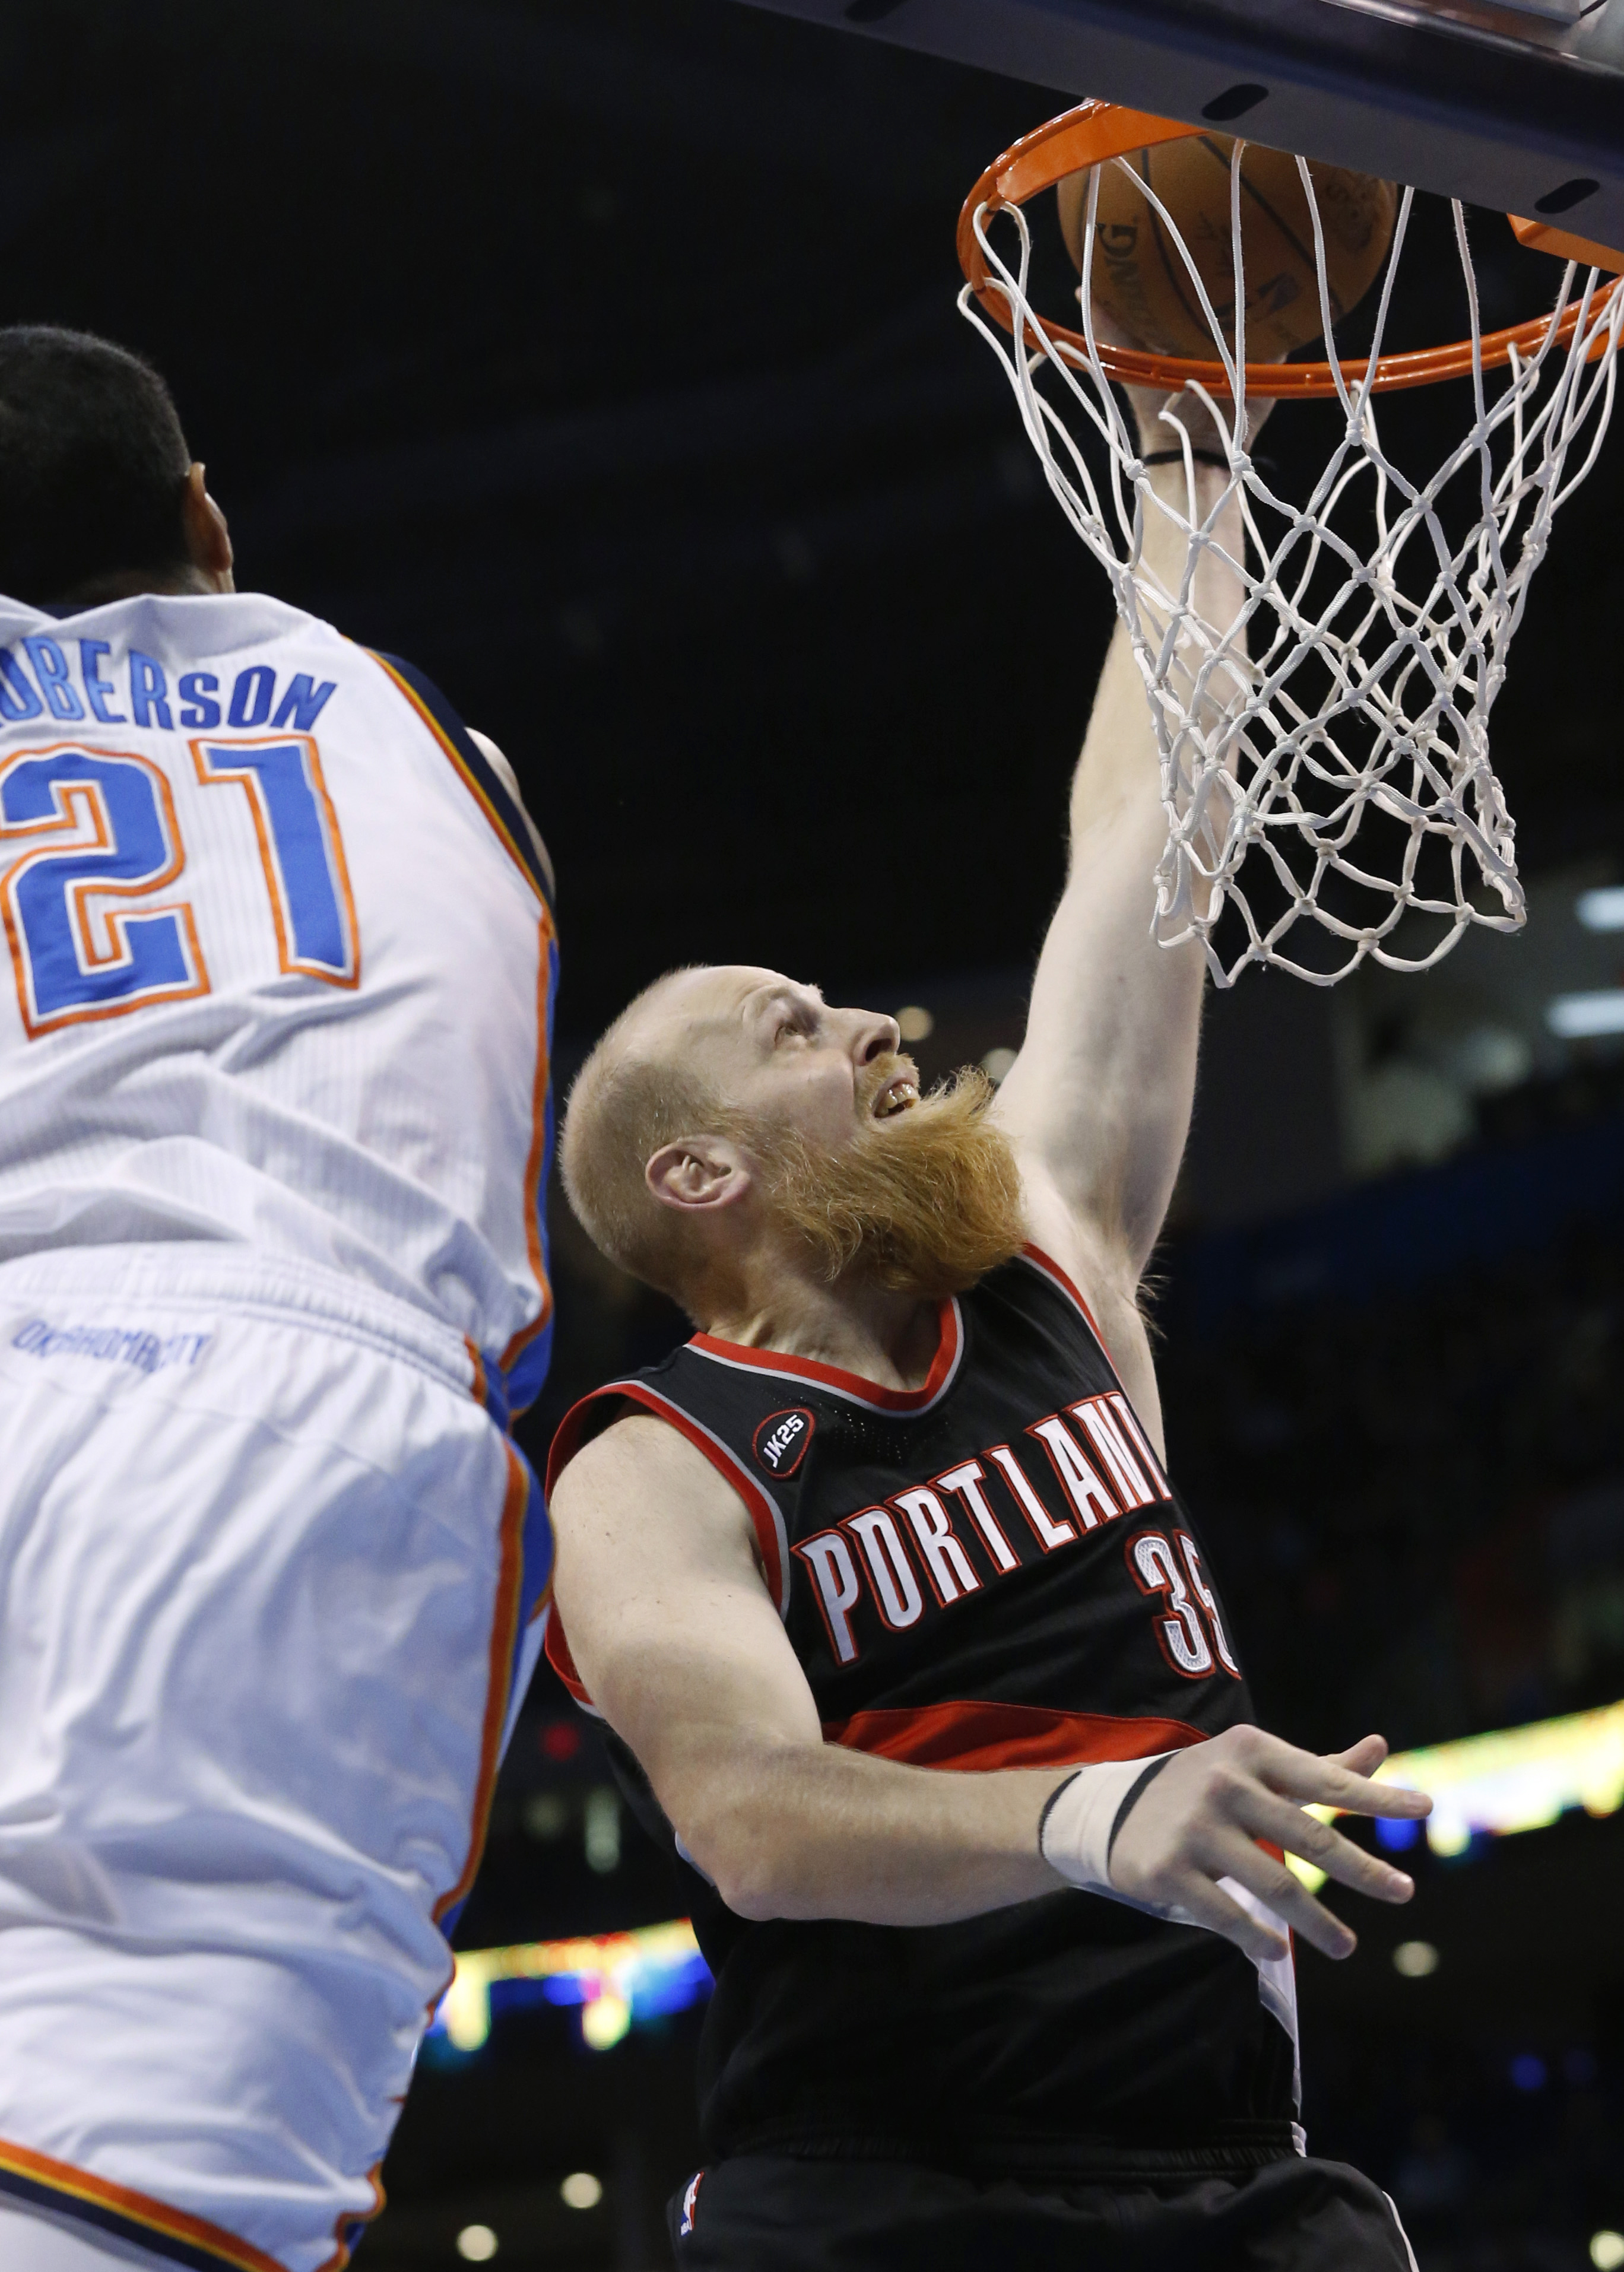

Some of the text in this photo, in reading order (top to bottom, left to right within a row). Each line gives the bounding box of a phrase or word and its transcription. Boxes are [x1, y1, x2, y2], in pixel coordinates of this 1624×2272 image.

[0, 636, 337, 731] OBERSON
[0, 735, 360, 1041] 21
[763, 1414, 804, 1468] JK25
